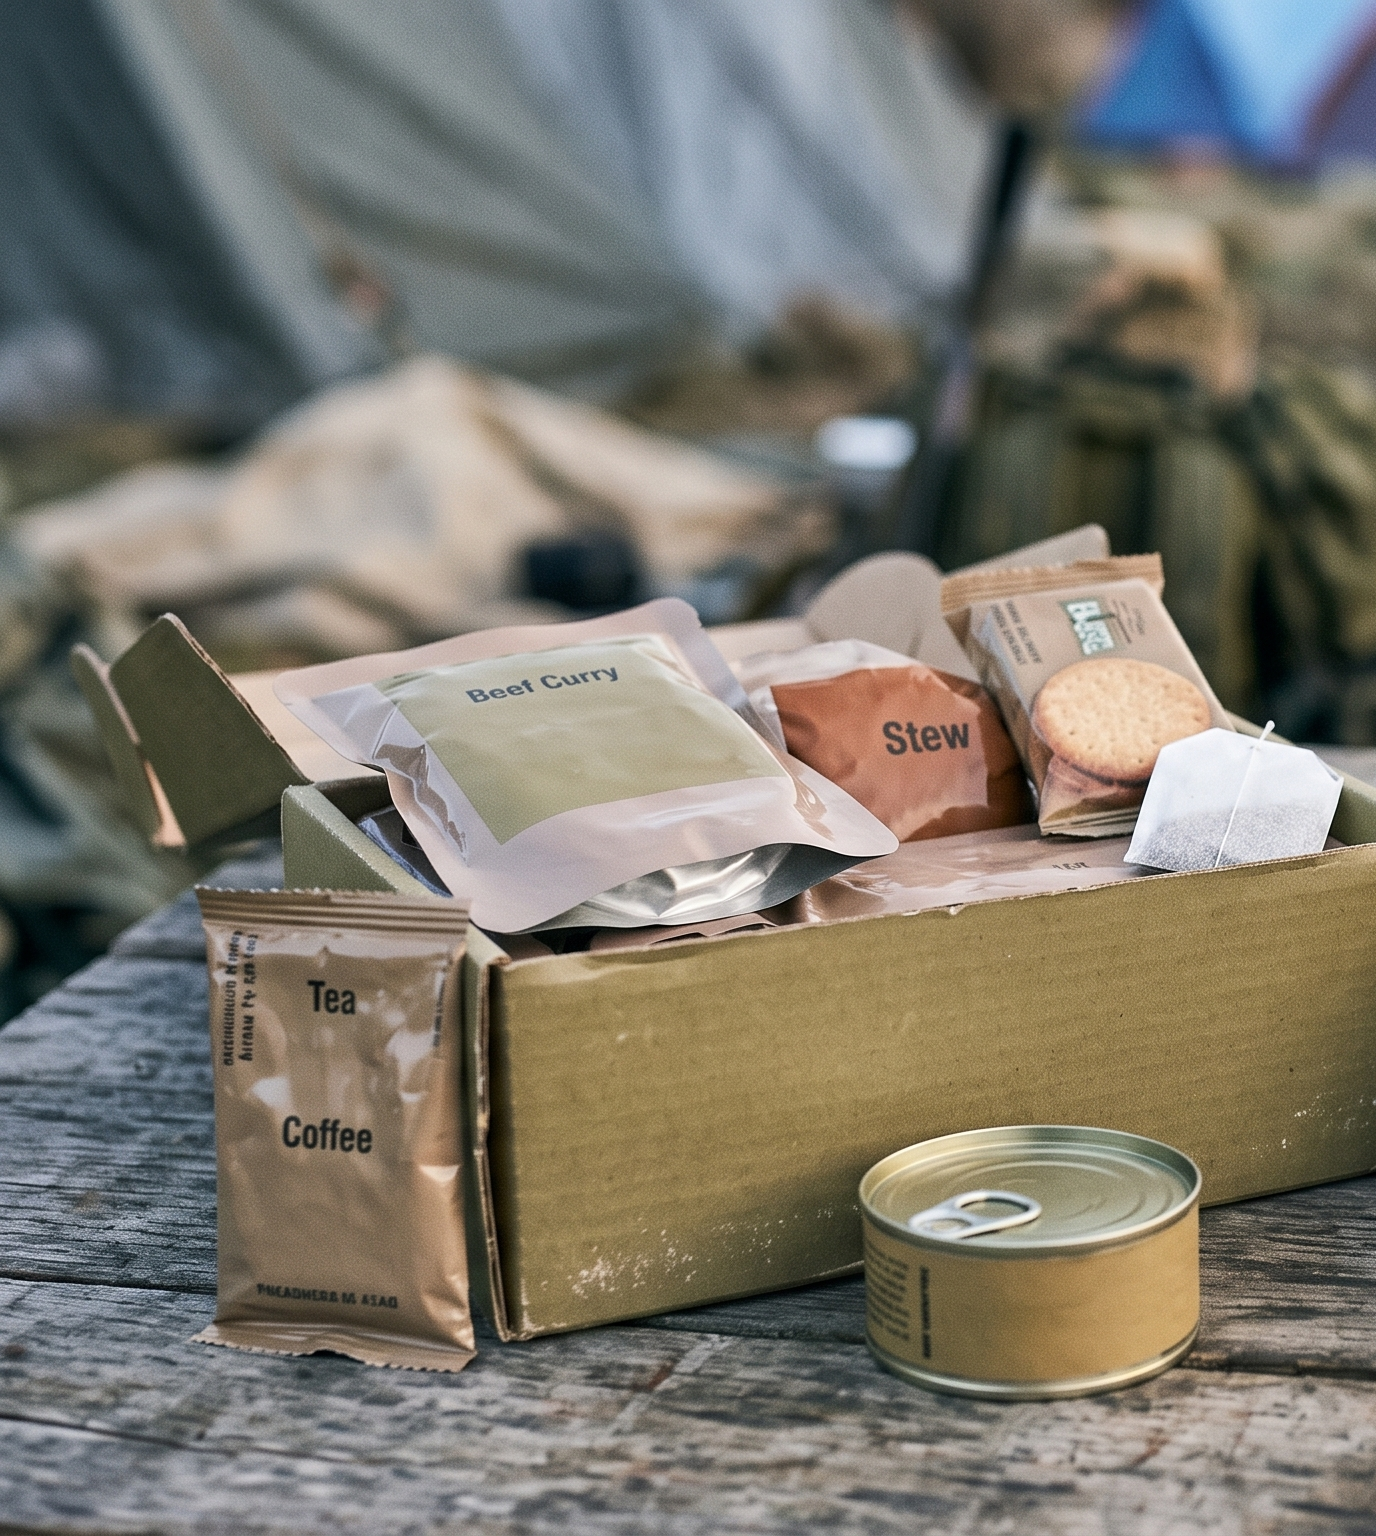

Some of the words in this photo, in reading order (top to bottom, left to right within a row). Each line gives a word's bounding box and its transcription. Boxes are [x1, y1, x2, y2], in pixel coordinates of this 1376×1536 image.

[466, 679, 535, 703] Beef
[540, 667, 619, 690] Curry
[882, 720, 969, 756] Stew
[307, 979, 356, 1015] Tea
[282, 1114, 373, 1154] Coffee
